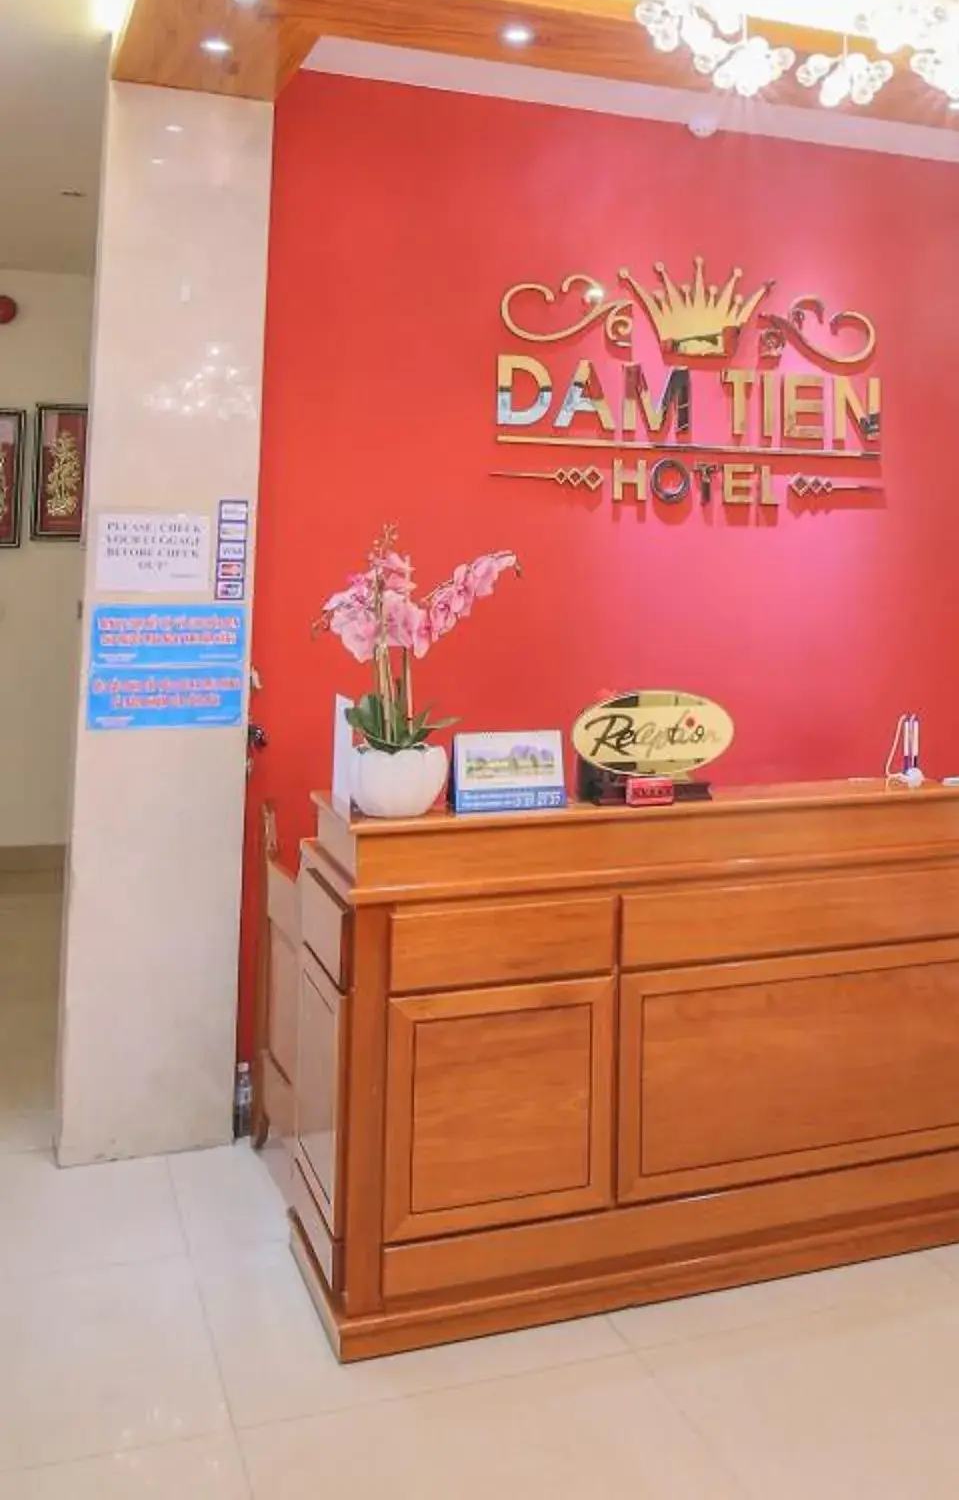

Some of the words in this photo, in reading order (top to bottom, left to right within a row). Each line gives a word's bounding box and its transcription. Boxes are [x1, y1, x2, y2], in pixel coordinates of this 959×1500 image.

[496, 354, 690, 434] DAM
[720, 368, 881, 441] TIEN
[611, 457, 780, 506] HOTEL
